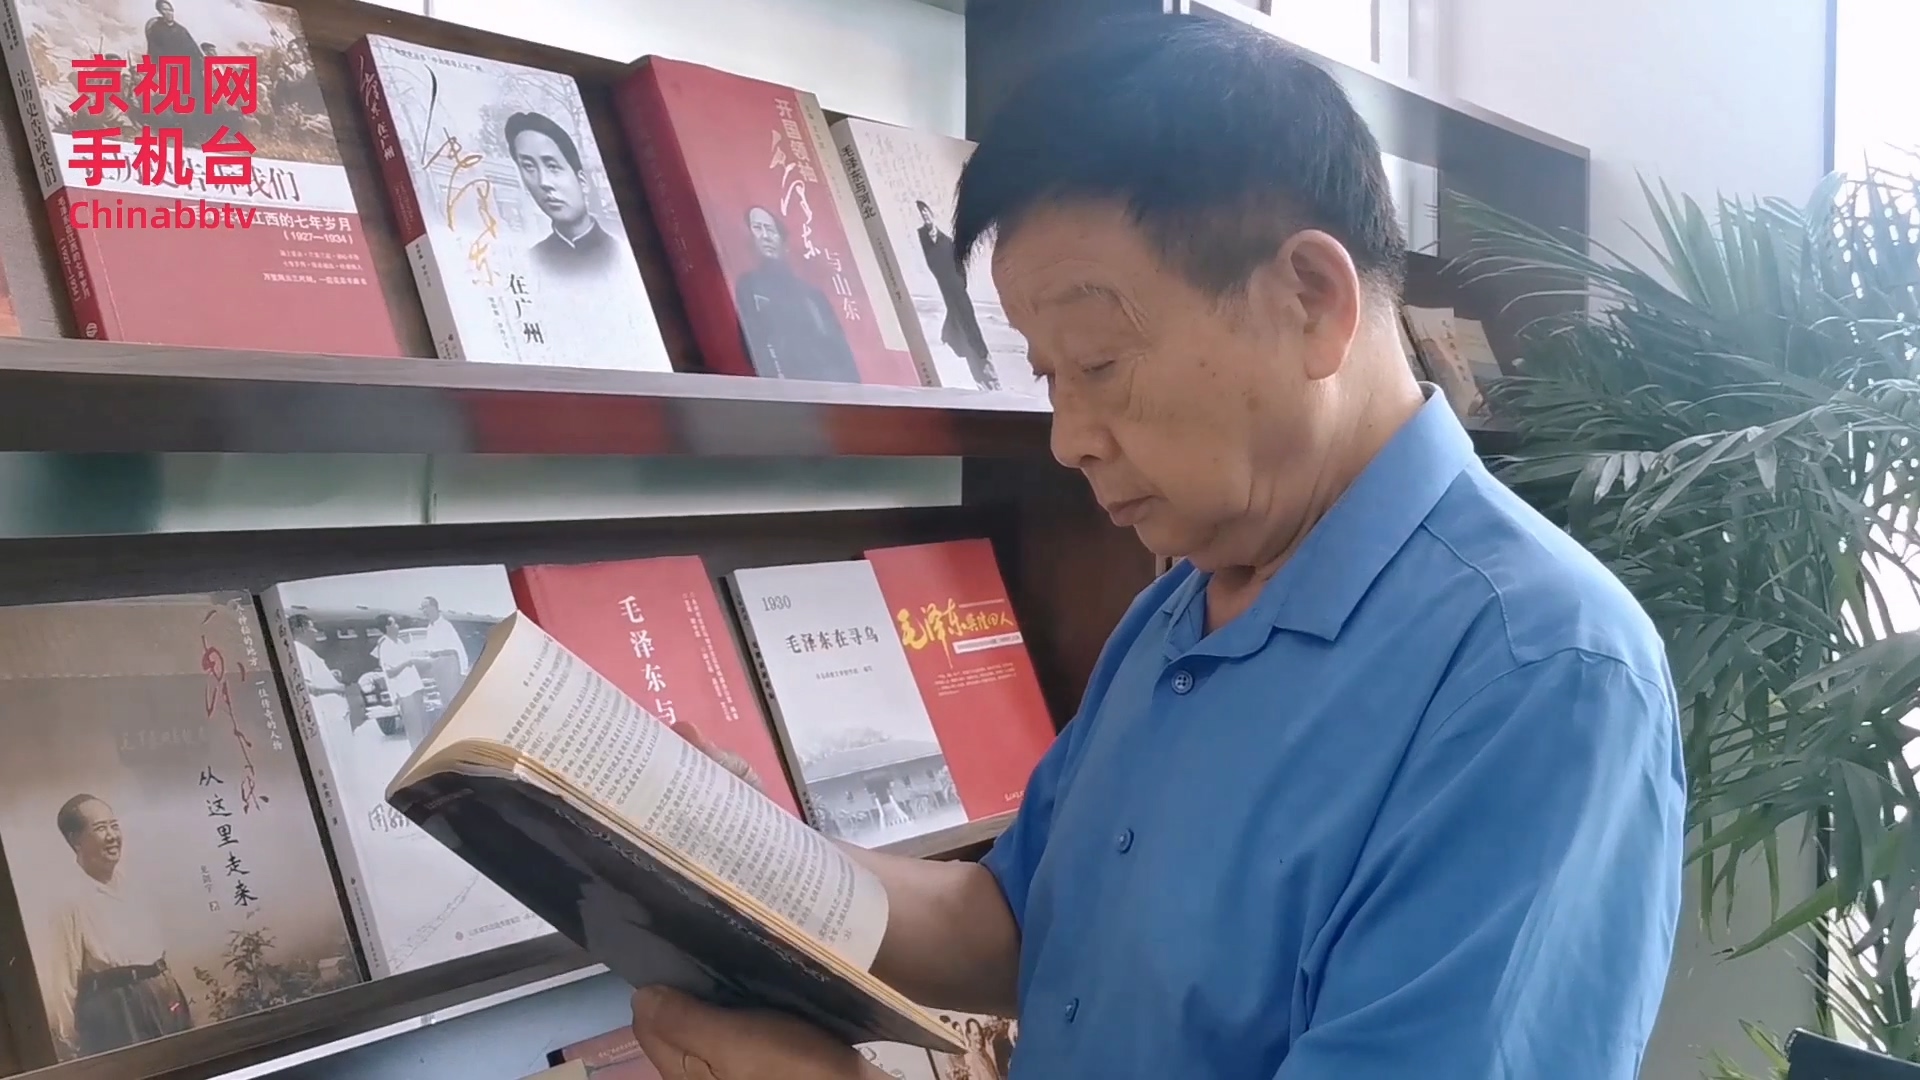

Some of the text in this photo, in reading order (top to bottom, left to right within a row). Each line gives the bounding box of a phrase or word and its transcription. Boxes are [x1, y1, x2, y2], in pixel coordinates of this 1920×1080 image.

[16, 69, 58, 189] 让历史告诉我们
[774, 97, 818, 184] 开国领袖
[507, 273, 545, 345] 在广州
[824, 247, 862, 322] 与山东
[762, 595, 792, 612] 1930
[785, 625, 879, 654] 毛泽东在寻乌
[617, 595, 678, 725] 毛泽东与
[198, 765, 259, 907] 从这里走来
